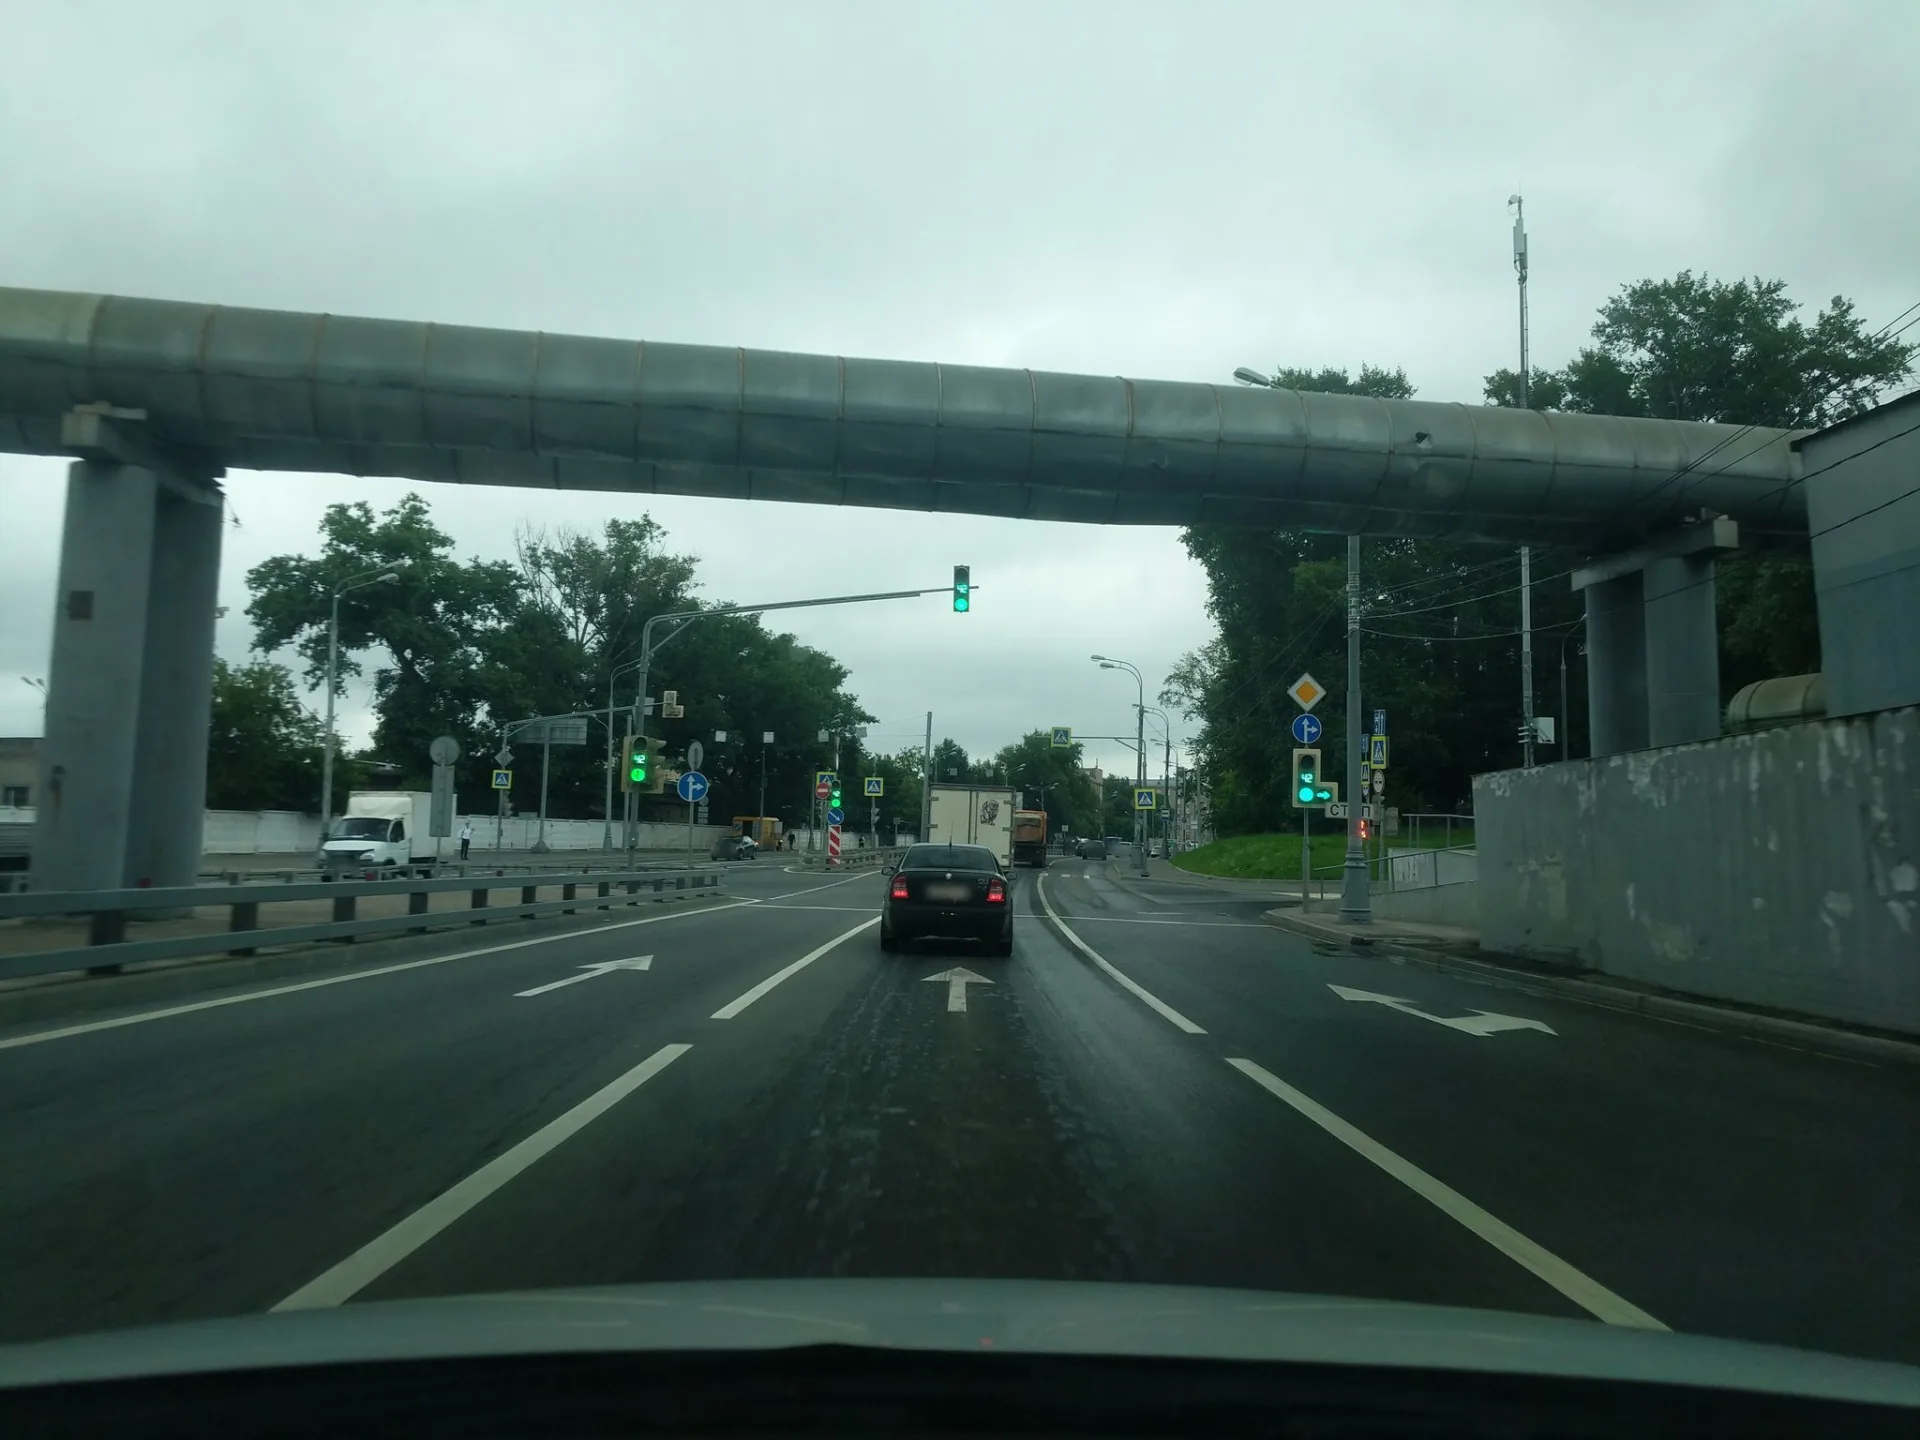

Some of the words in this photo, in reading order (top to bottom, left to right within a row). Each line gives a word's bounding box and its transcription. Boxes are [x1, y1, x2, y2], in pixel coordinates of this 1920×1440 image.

[956, 583, 968, 594] 42
[633, 754, 646, 764] 42
[1301, 773, 1314, 783] 42
[1329, 803, 1371, 818] СТП
